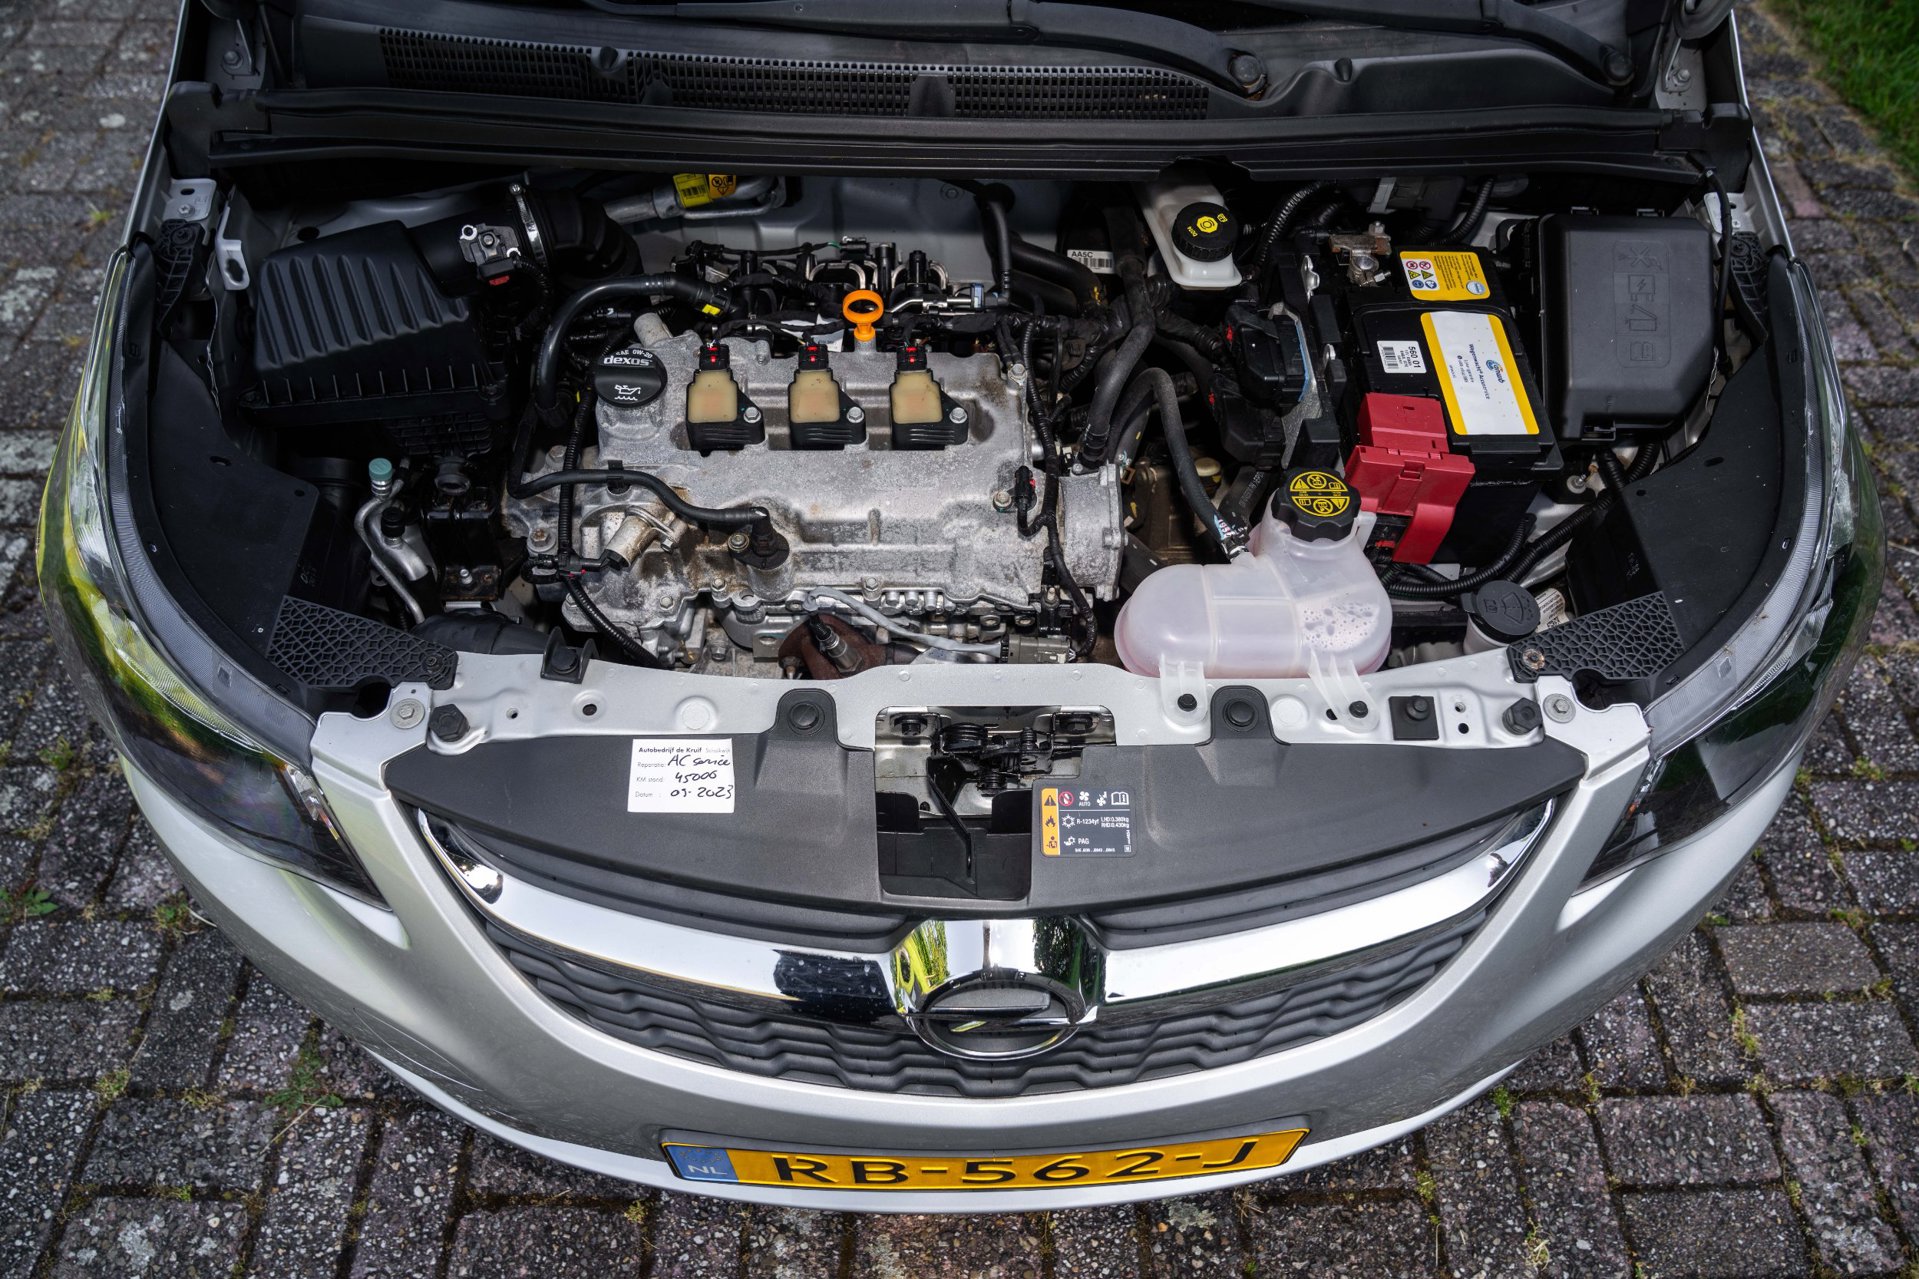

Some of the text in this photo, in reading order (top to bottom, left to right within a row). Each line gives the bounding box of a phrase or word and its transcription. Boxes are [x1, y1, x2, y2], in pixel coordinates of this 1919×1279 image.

[1408, 346, 1418, 359] 560
[603, 355, 650, 366] dexos
[1412, 360, 1421, 368] 01
[667, 754, 691, 767] AC
[697, 784, 734, 799] 2023
[771, 1140, 1258, 1184] RB-562-J
[688, 1164, 728, 1176] NL
